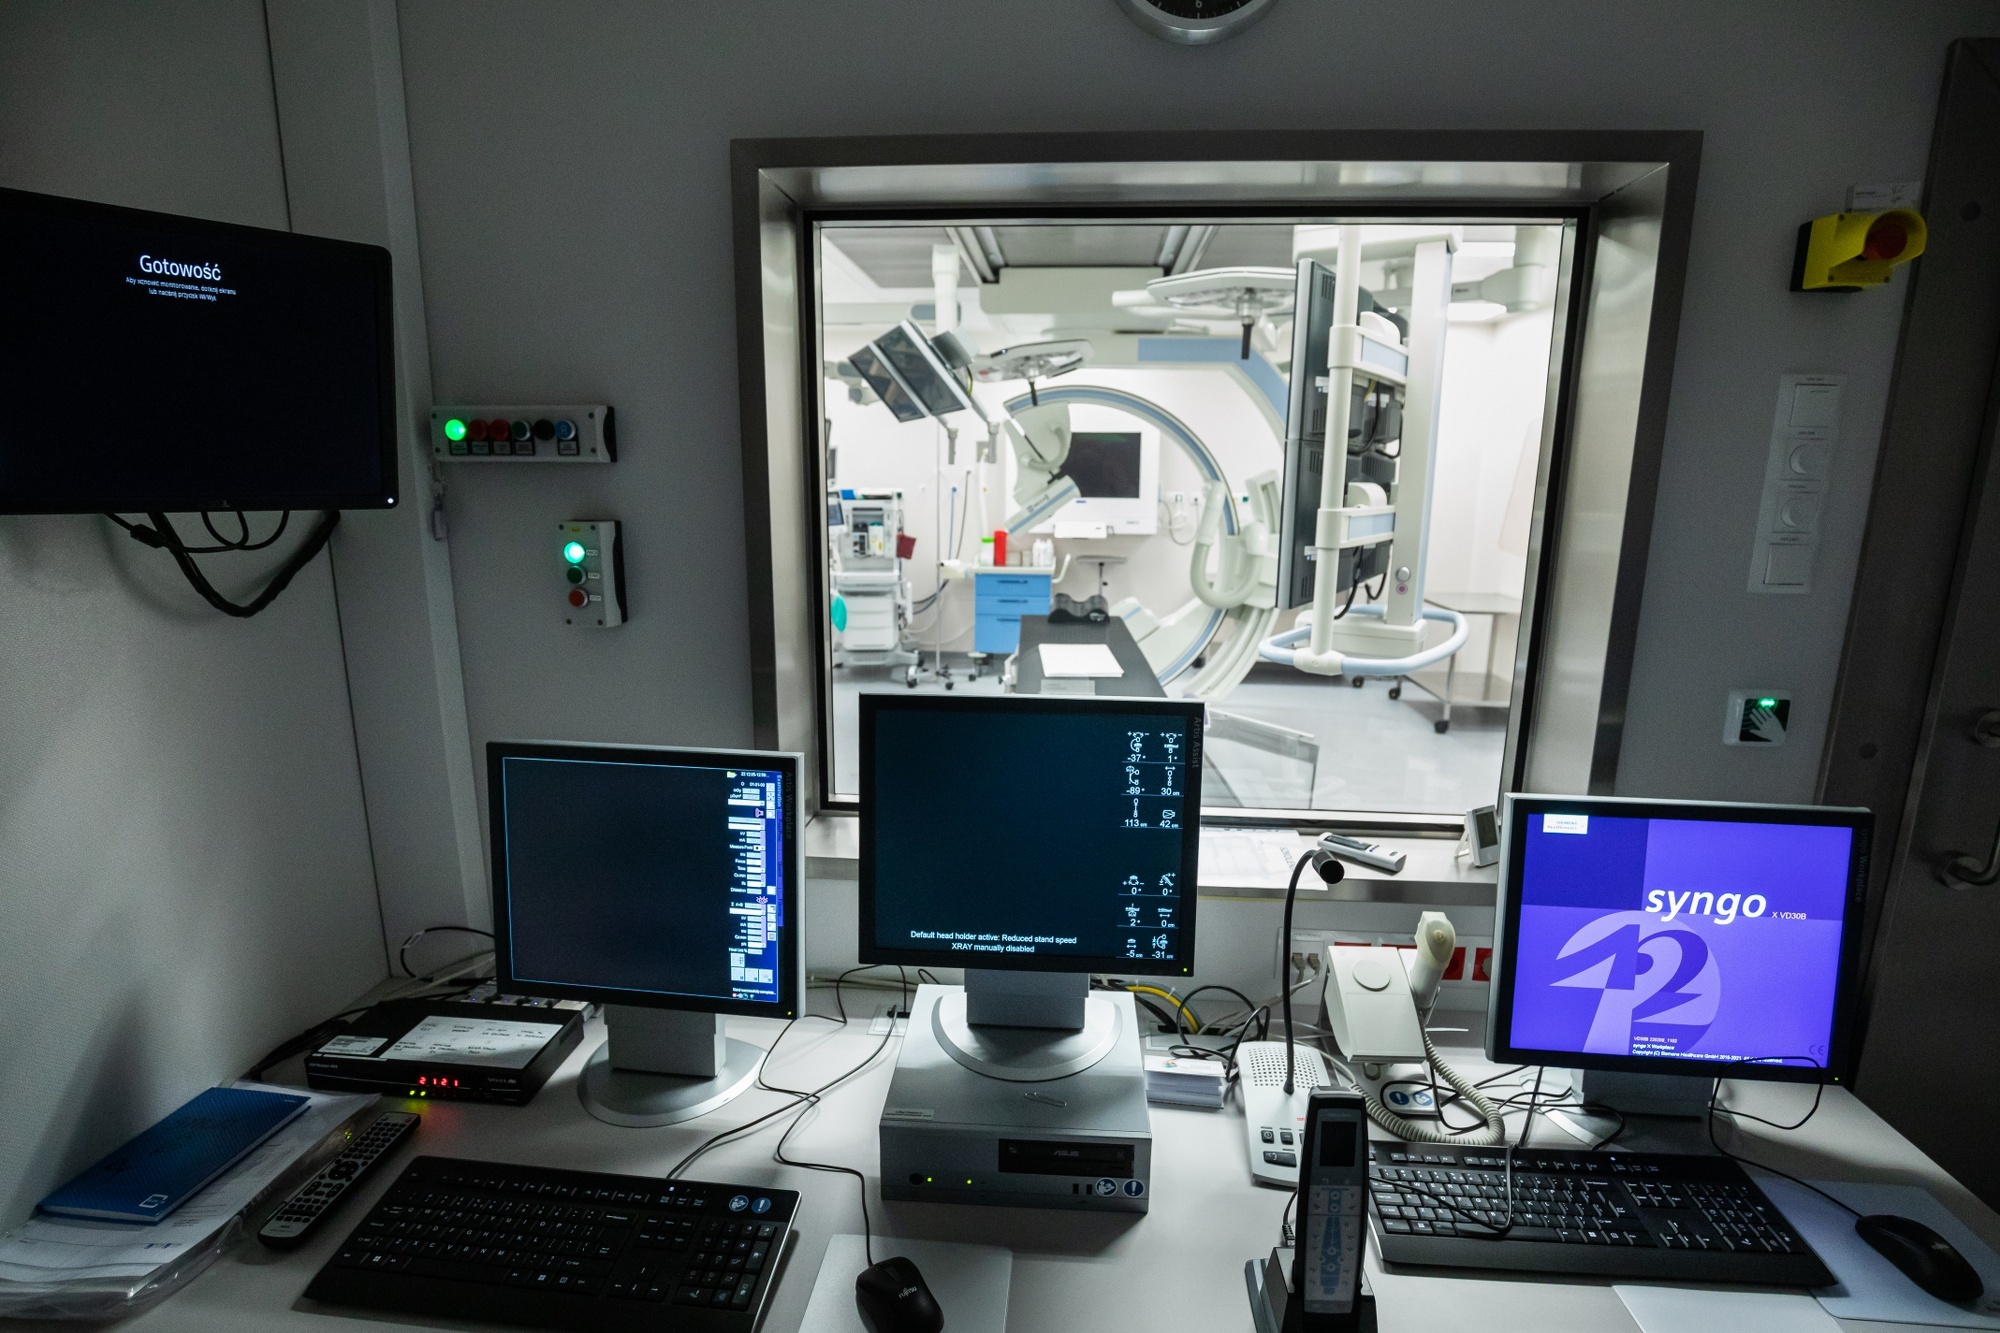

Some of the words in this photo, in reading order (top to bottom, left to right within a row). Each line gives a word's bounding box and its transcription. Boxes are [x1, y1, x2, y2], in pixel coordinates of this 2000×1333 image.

[140, 255, 221, 280] Gotowość
[1193, 716, 1202, 739] Artis
[1192, 741, 1200, 768] Assist
[1855, 855, 1868, 902] Workplace
[1645, 890, 1766, 925] syngo
[911, 930, 935, 939] Default
[1002, 934, 1033, 942] Reduced
[974, 944, 1004, 953] manually
